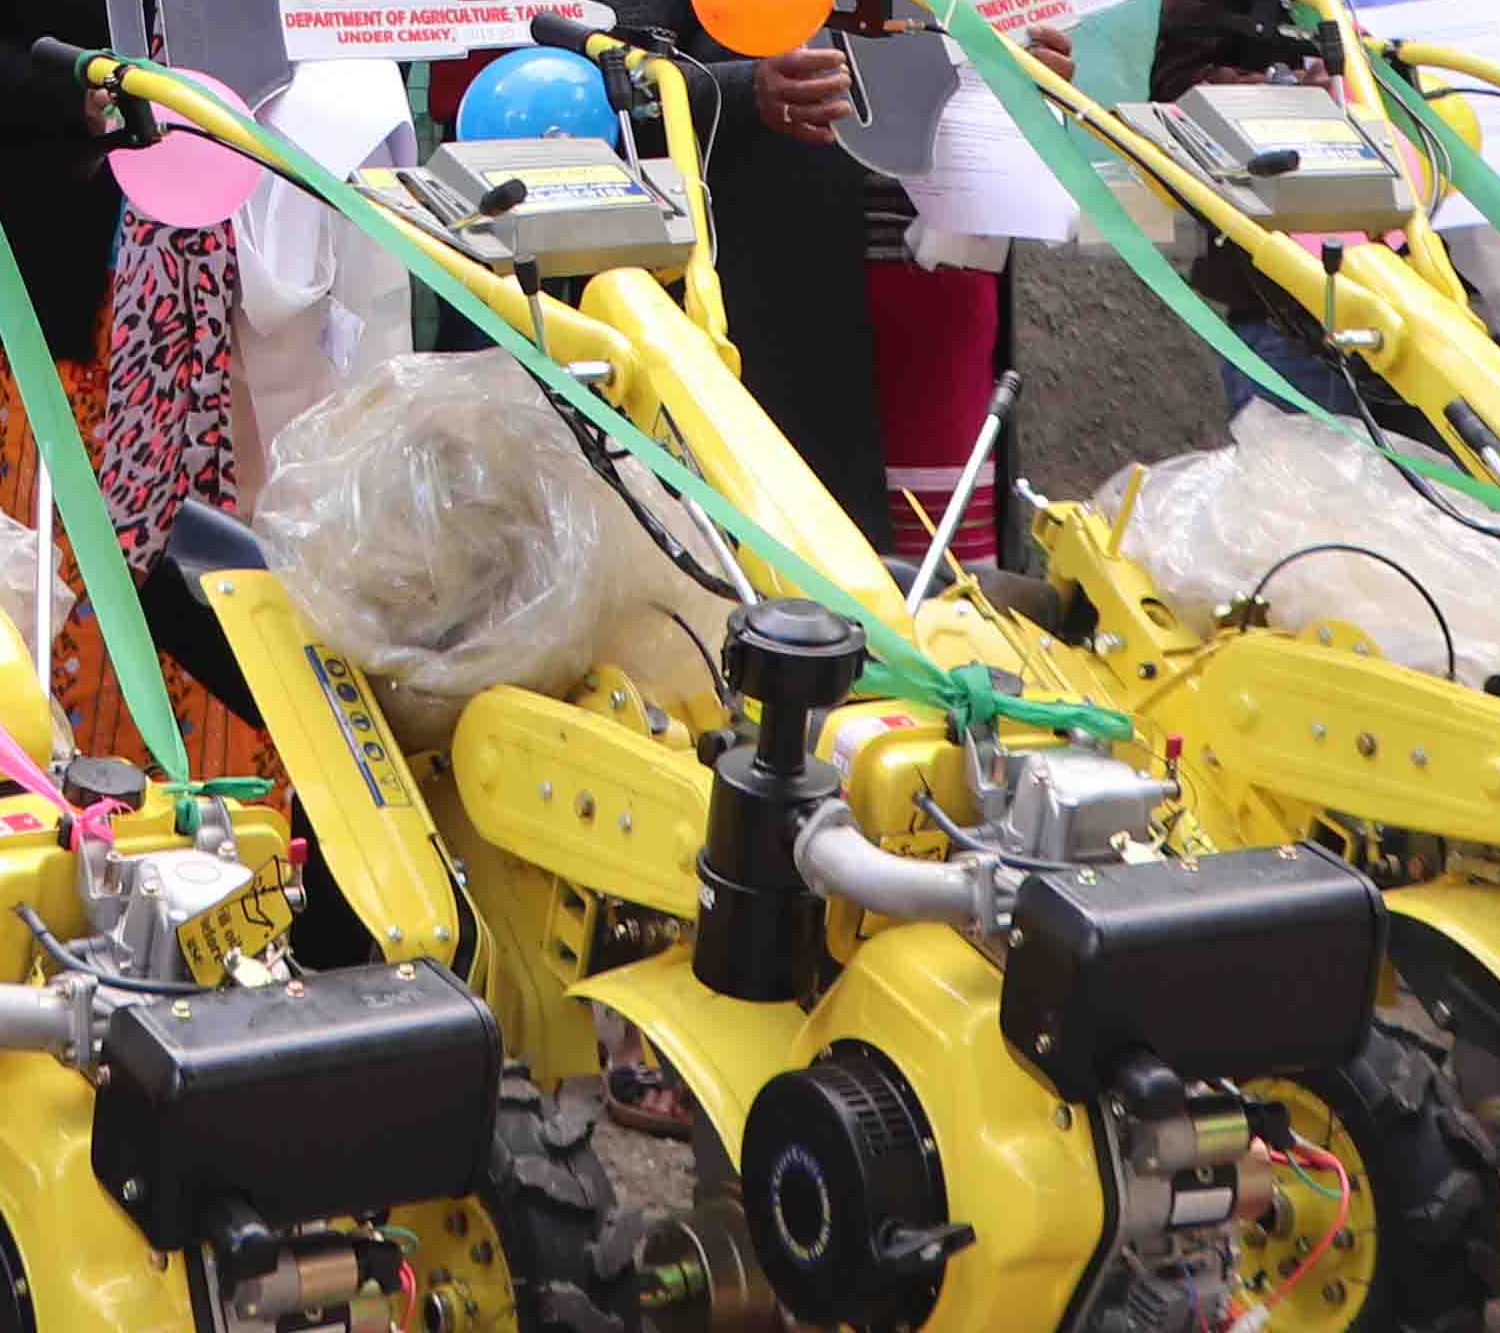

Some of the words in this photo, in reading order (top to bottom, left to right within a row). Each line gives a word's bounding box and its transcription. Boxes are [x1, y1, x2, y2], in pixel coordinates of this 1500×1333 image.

[285, 9, 385, 29] DEPARTMENT
[386, 9, 405, 25] OF
[337, 30, 394, 44] UNDER
